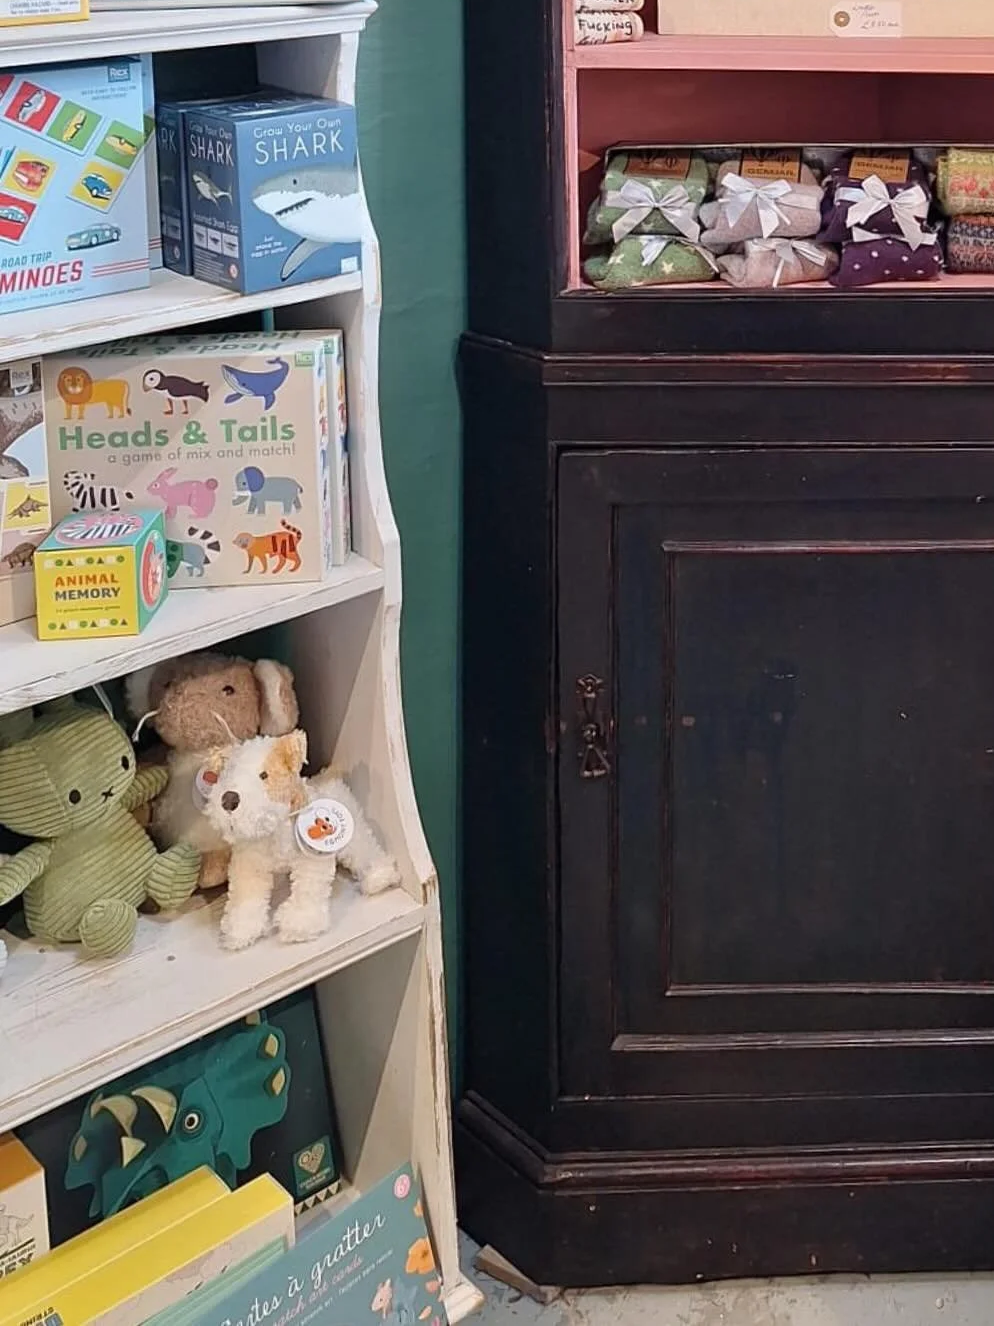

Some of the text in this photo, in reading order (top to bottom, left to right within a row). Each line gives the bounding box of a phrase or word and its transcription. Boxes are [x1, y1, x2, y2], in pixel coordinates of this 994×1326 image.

[253, 117, 342, 139] Grow Your Own
[190, 133, 234, 167] SHARK
[255, 130, 344, 165] SHARK
[1, 251, 52, 269] ROAD TRIP
[75, 346, 139, 359] Tails
[188, 342, 282, 355] Heads
[58, 415, 296, 451] Heads & Tails
[107, 442, 296, 466] a game of mix and match!
[55, 573, 119, 588] ANIMAL
[55, 586, 121, 601] MEMORY
[221, 1213, 386, 1326] rtes à gratter
